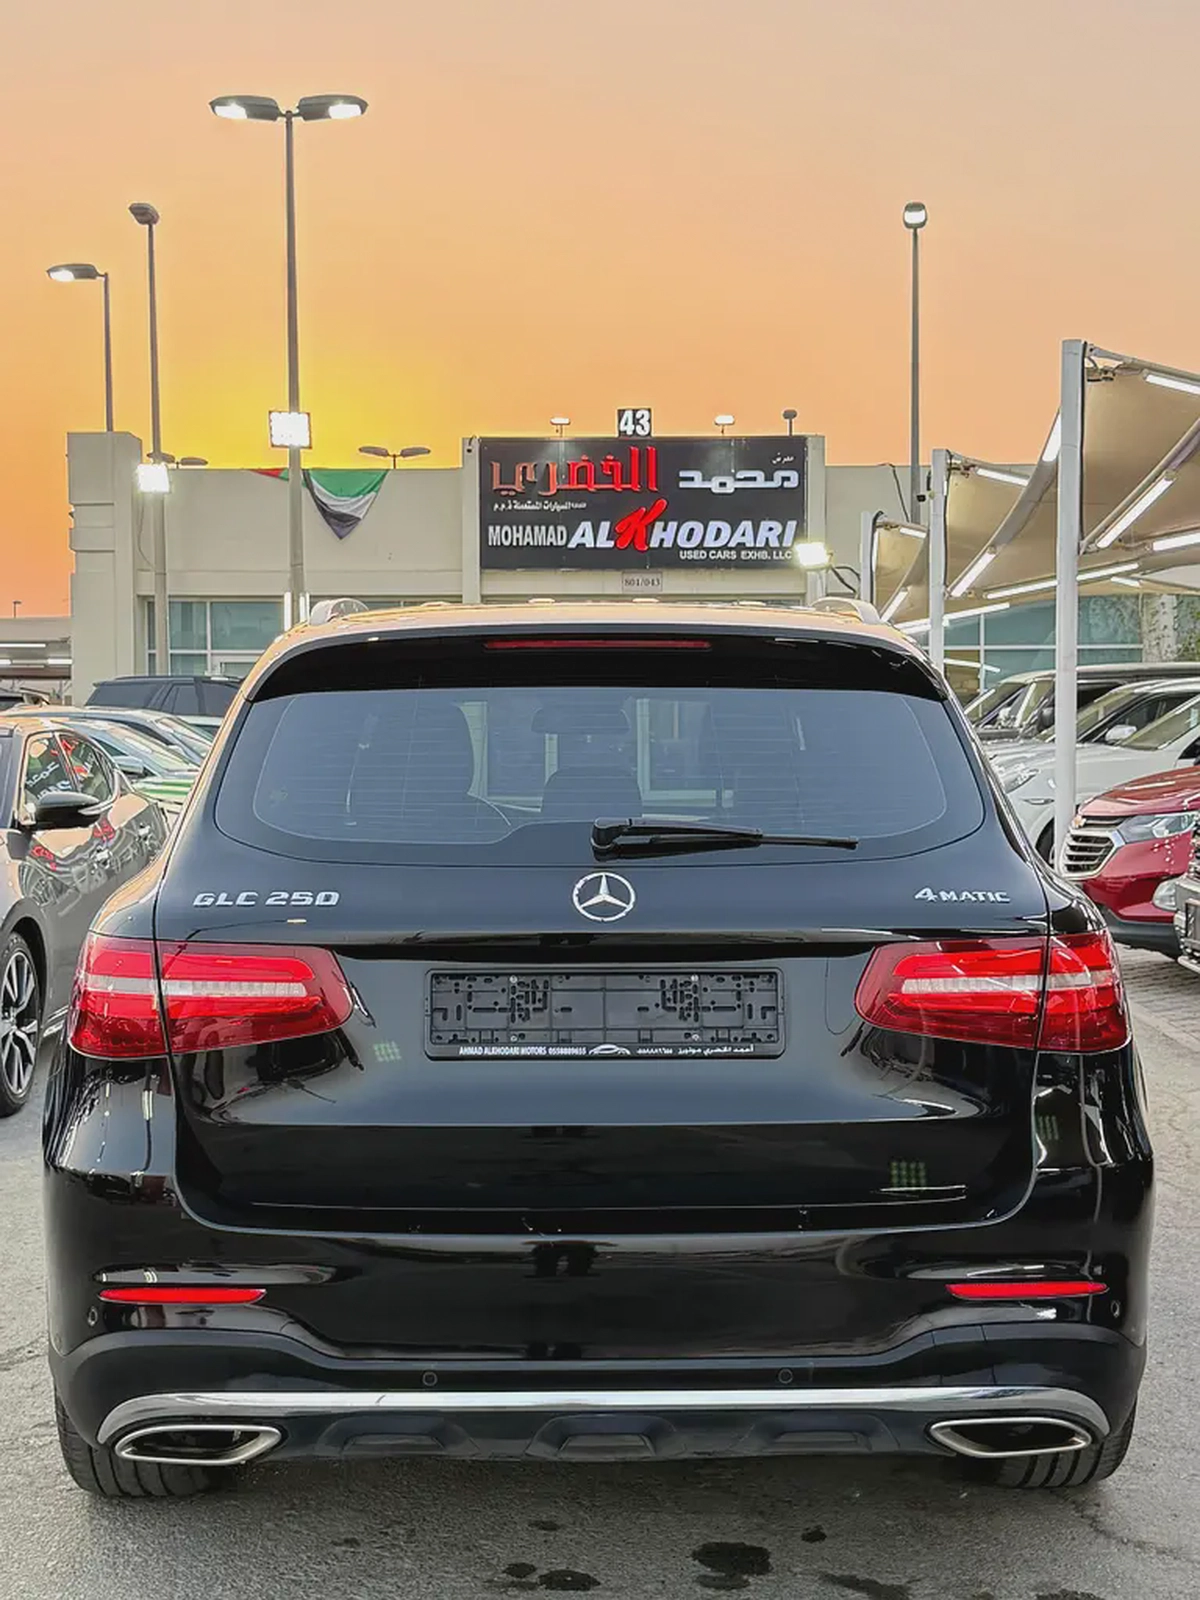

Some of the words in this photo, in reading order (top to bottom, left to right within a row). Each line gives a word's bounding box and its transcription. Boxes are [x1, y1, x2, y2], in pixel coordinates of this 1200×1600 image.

[619, 409, 650, 436] 43
[490, 445, 659, 497] الخضري
[678, 469, 799, 494] محمد
[487, 524, 568, 547] MOHAMAD
[567, 498, 798, 551] ALKHODARI
[679, 550, 707, 560] USED
[708, 550, 737, 560] CARS
[772, 550, 793, 560] LLC
[193, 891, 259, 907] GLC
[264, 890, 340, 906] 250
[914, 887, 1011, 903] 4MATIC
[521, 1045, 547, 1056] MOTORS
